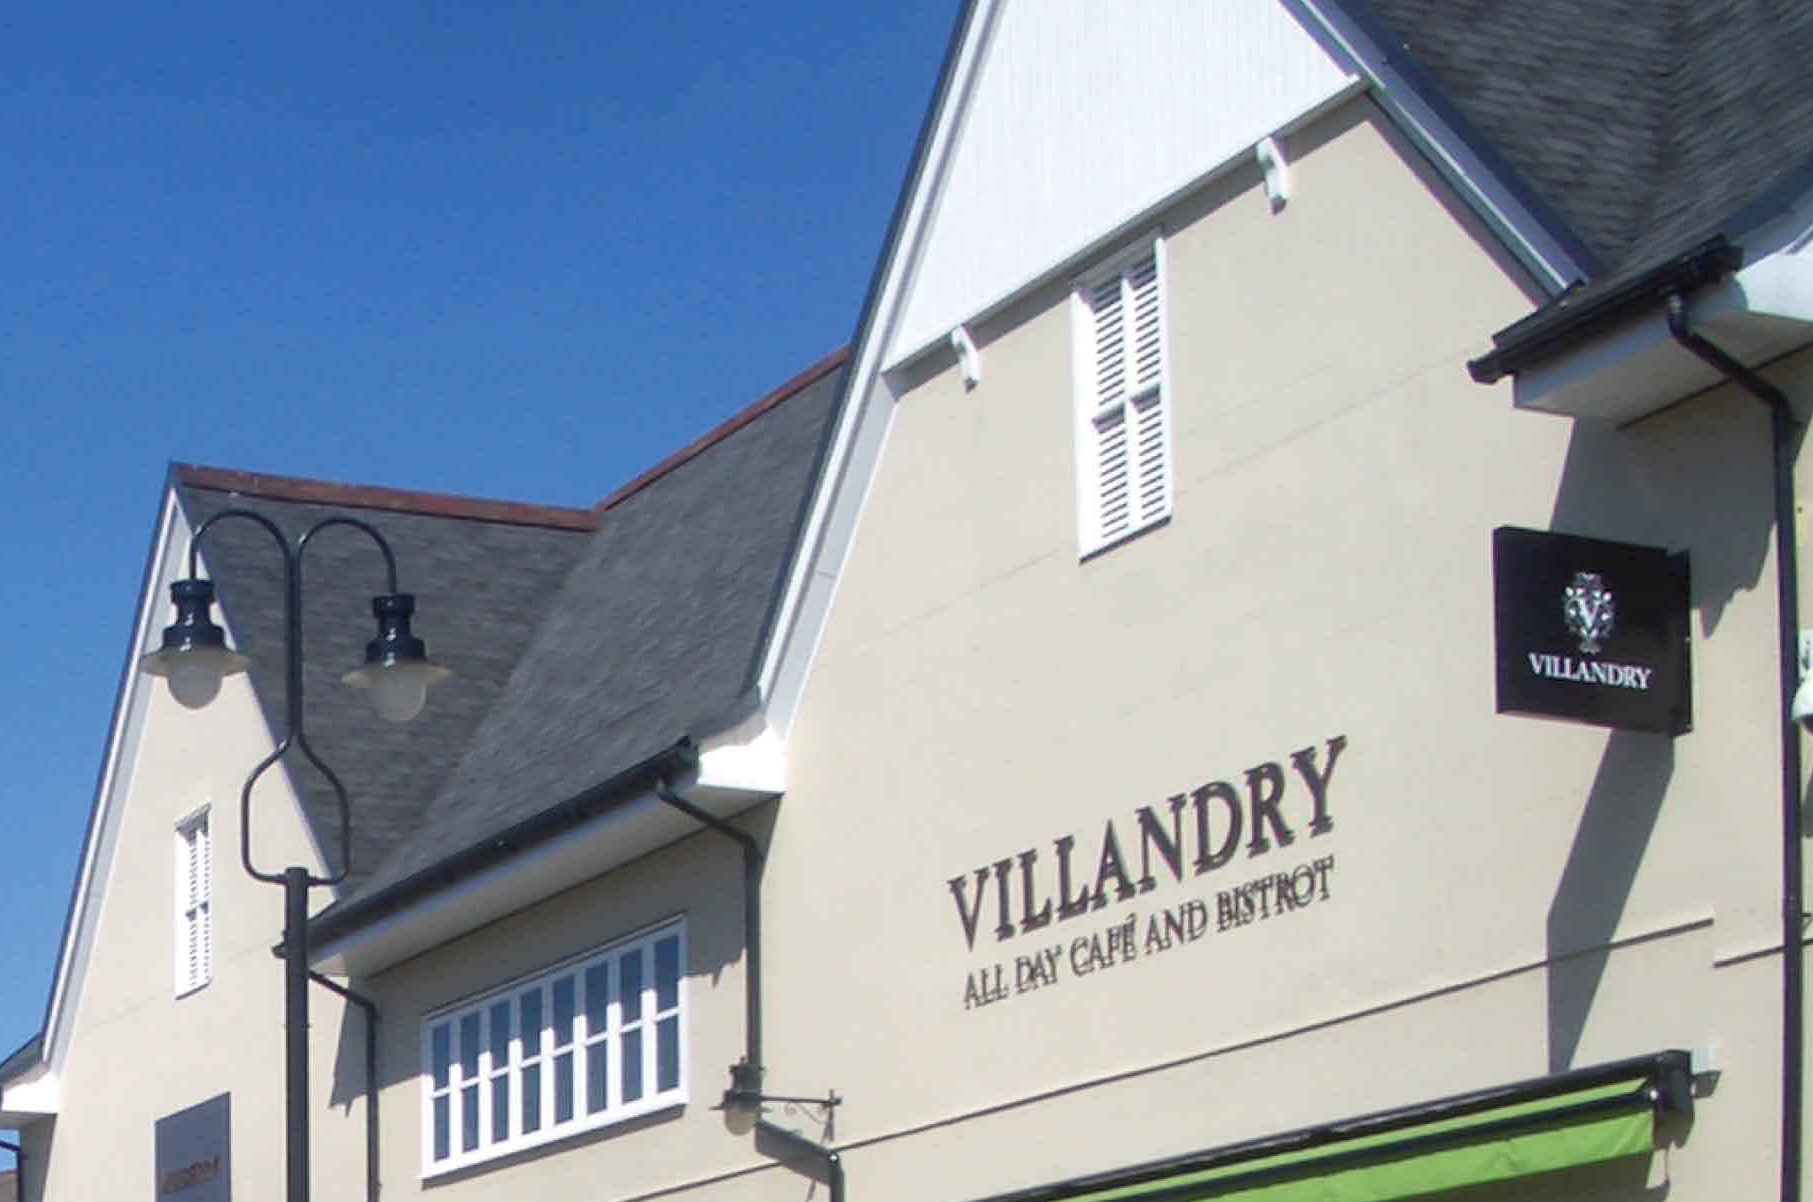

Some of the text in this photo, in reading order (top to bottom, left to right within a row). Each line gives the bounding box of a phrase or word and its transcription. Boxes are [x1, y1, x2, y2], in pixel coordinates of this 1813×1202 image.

[1528, 652, 1652, 690] VILLANDRY
[947, 735, 1348, 953] VILLANDRY
[963, 963, 1008, 1010] ALL
[1015, 943, 1062, 996] DAY
[1144, 898, 1207, 958] AND
[1215, 853, 1336, 932] BISTROT
